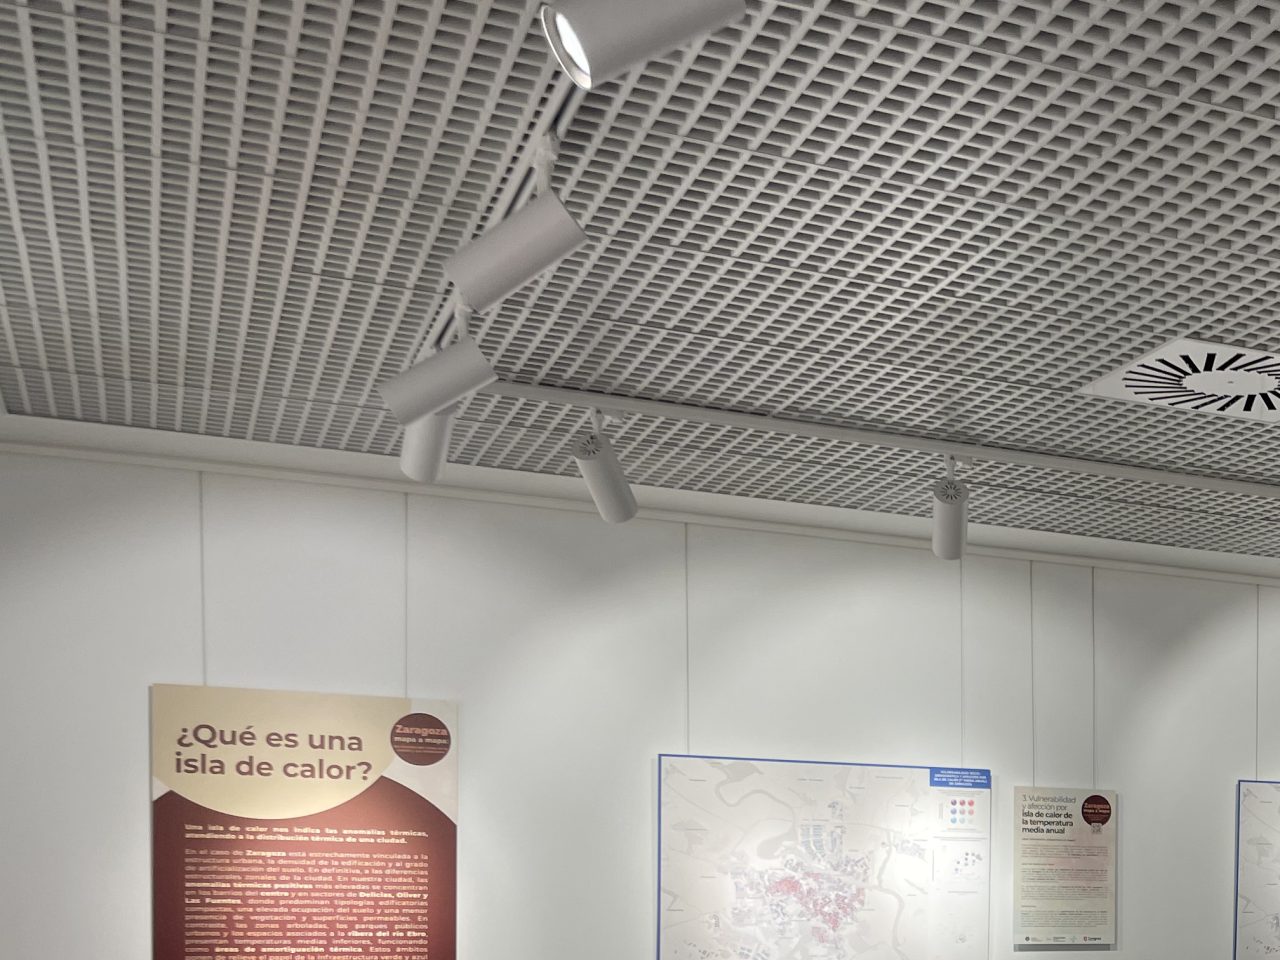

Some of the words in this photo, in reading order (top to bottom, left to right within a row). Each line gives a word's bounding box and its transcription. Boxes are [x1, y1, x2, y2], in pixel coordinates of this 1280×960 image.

[177, 724, 257, 749] ¿Qué
[266, 730, 299, 749] es
[308, 732, 364, 752] una
[395, 725, 448, 736] Zaragoza
[174, 752, 226, 776] isla
[235, 756, 273, 778] de
[283, 757, 373, 781] calor?
[246, 850, 286, 858] Zaragoza
